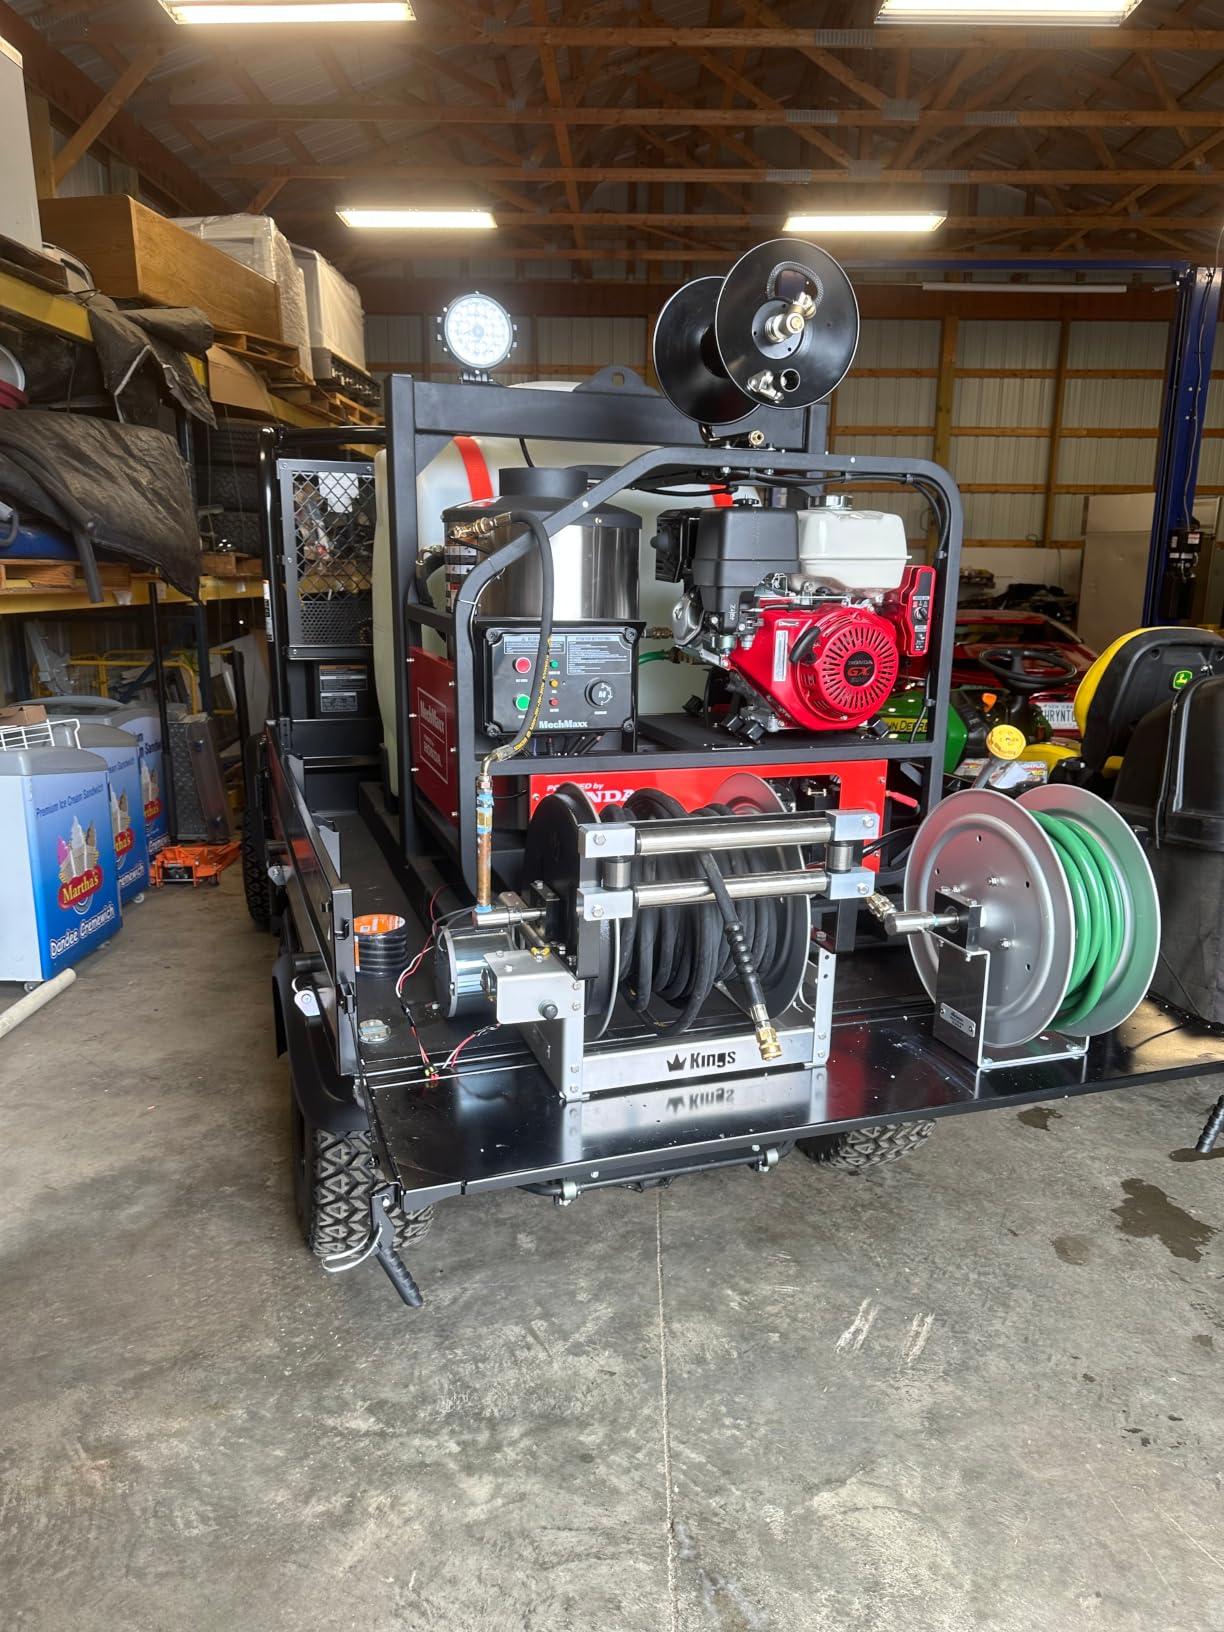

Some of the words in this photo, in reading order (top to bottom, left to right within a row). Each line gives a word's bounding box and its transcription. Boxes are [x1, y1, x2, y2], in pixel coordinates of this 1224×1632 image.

[848, 667, 870, 676] GX
[539, 720, 588, 728] MechMaxx
[592, 782, 604, 791] by
[36, 804, 58, 818] Premium
[59, 799, 67, 809] Ice
[67, 793, 83, 806] Cream
[83, 783, 104, 799] Sandwich
[62, 869, 99, 903] Martha's
[119, 864, 145, 888] remewich
[50, 929, 80, 959] Dandee
[690, 1051, 736, 1069] Kings
